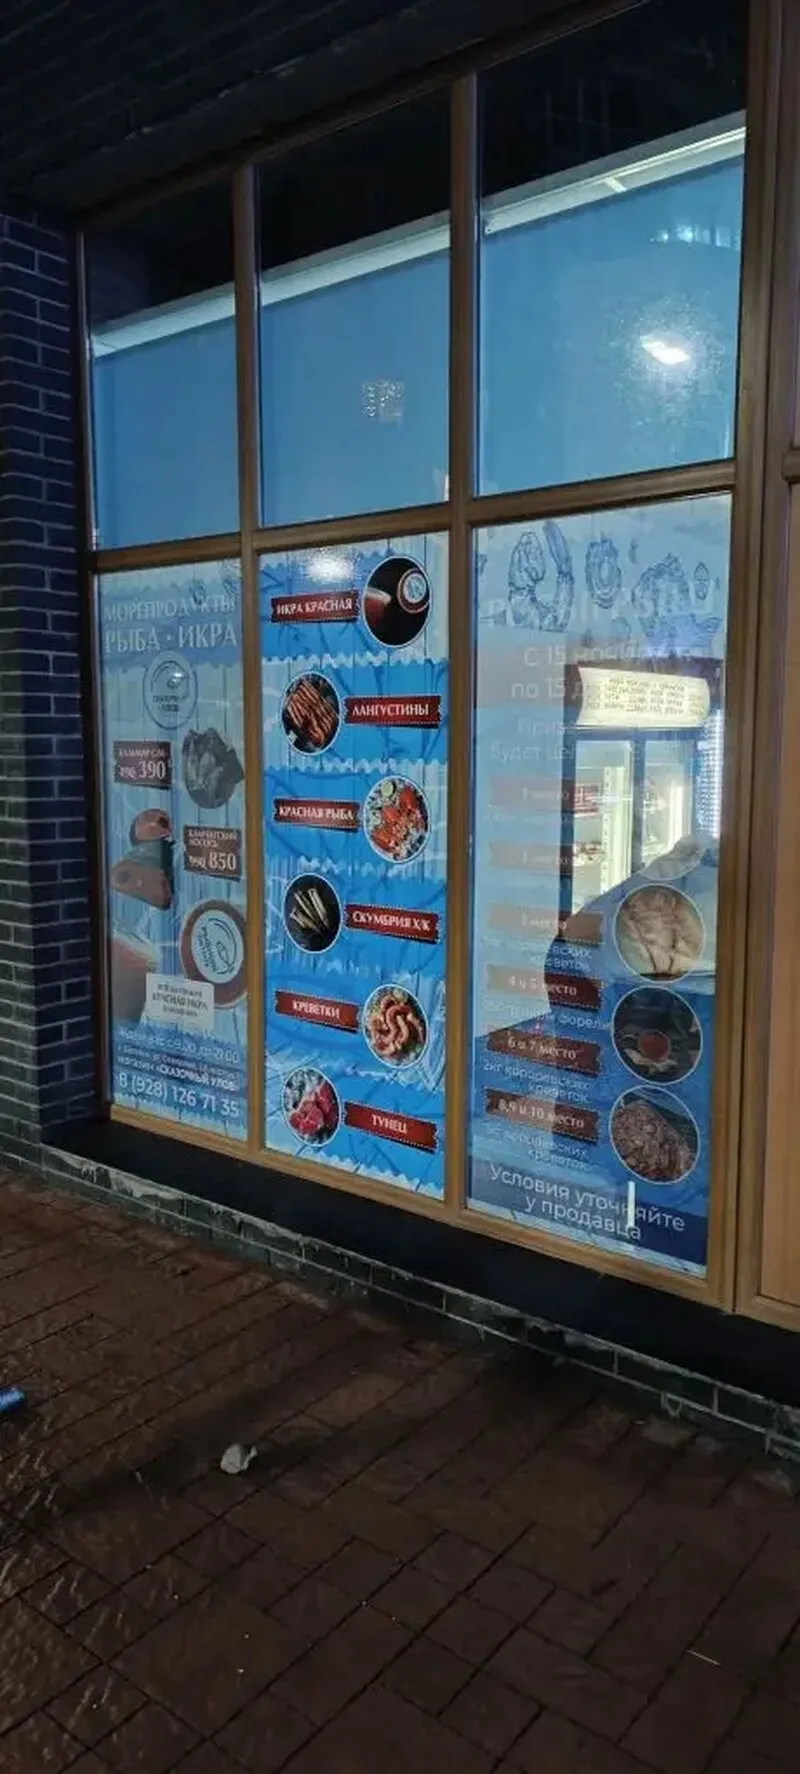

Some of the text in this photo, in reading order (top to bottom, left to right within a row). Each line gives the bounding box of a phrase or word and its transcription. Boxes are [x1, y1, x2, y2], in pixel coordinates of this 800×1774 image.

[103, 594, 237, 621] МОРЕПРОДУКТЫ
[277, 597, 353, 616] ИКРА КРАСНАЯ
[105, 623, 238, 653] РЫБА ИКРА
[511, 683, 538, 698] по
[352, 703, 430, 717] ЛАНГУСТИНЫ
[138, 760, 167, 780] 390
[279, 806, 354, 821] КРАСНАЯ РЫБА
[208, 852, 237, 871] 850
[352, 910, 412, 928] СКУМБРИЯ
[292, 999, 341, 1019] КРЕВЕТКИ
[507, 1035, 577, 1059] 6 и 7 место
[483, 1059, 502, 1072] 2кг
[119, 1072, 240, 1118] 8 (928) 126 71 35
[528, 1083, 590, 1103] креветок
[371, 1114, 408, 1135] ТУНЕЦ
[519, 1104, 528, 1115] и
[531, 1106, 545, 1119] 10
[547, 1112, 585, 1129] место
[490, 1163, 686, 1232] Условия уточняйте
[525, 1195, 642, 1242] у продавца
